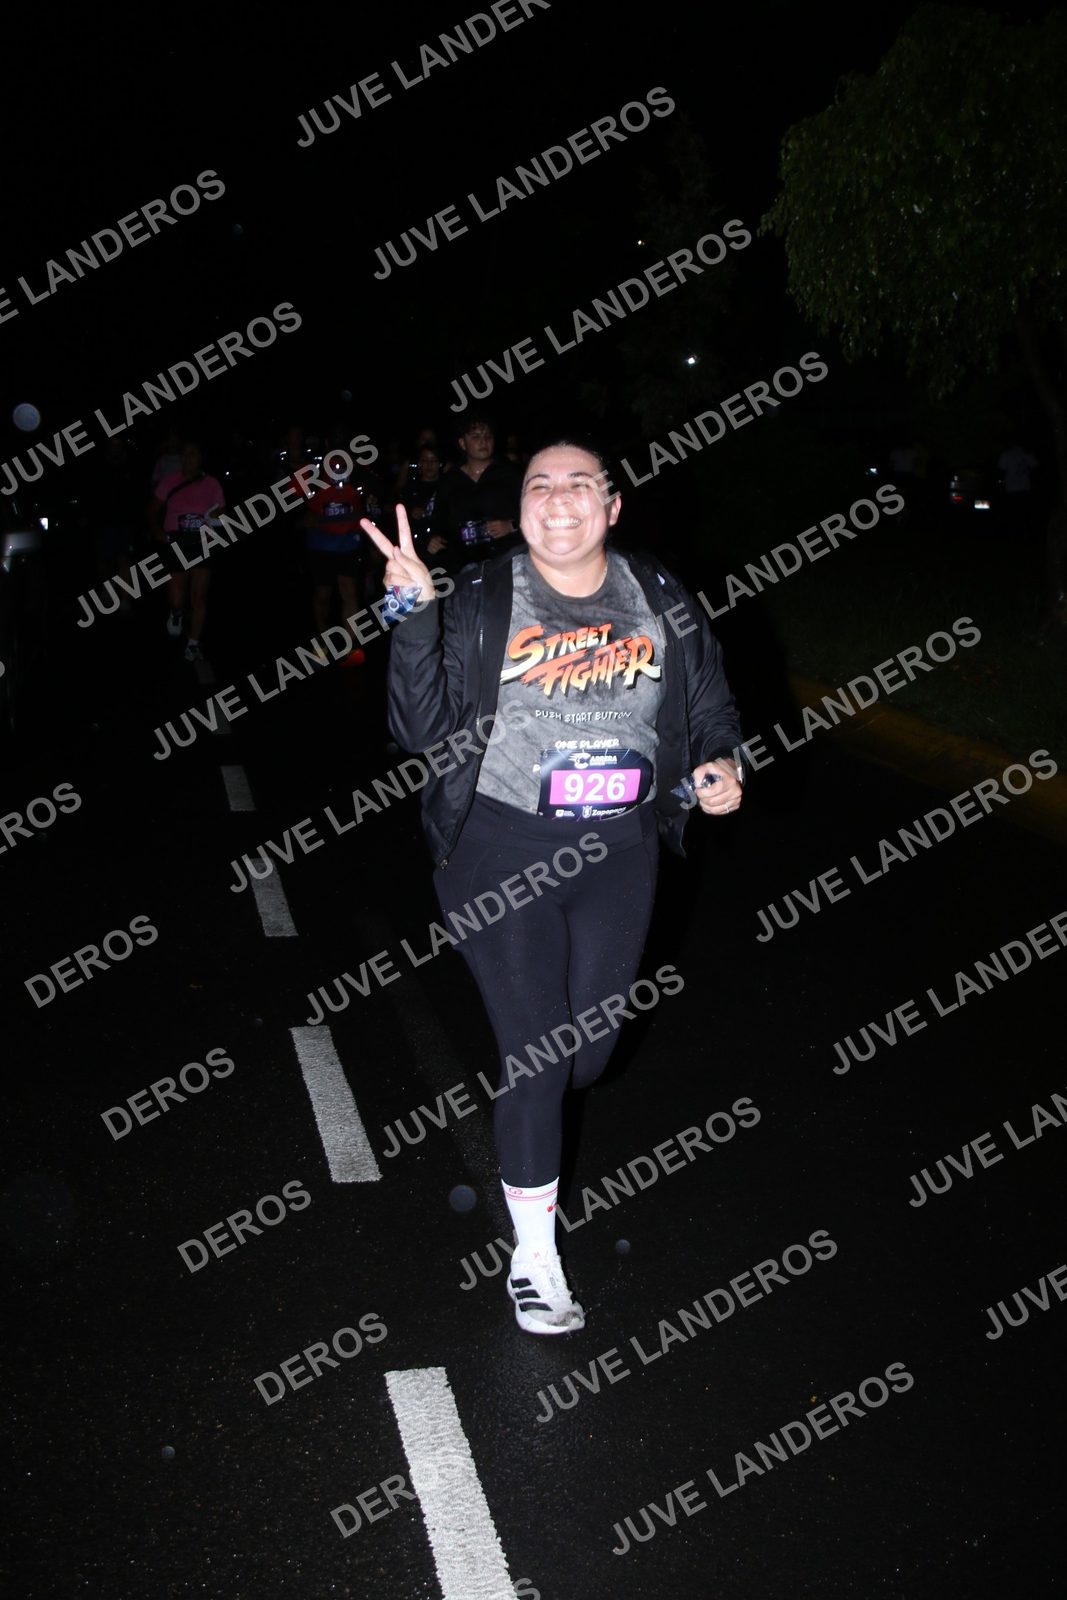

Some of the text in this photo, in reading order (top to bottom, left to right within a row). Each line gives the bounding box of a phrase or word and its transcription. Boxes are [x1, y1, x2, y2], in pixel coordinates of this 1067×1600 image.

[500, 623, 612, 684] STREET
[520, 635, 662, 697] FIGHTER
[564, 773, 626, 802] 926
